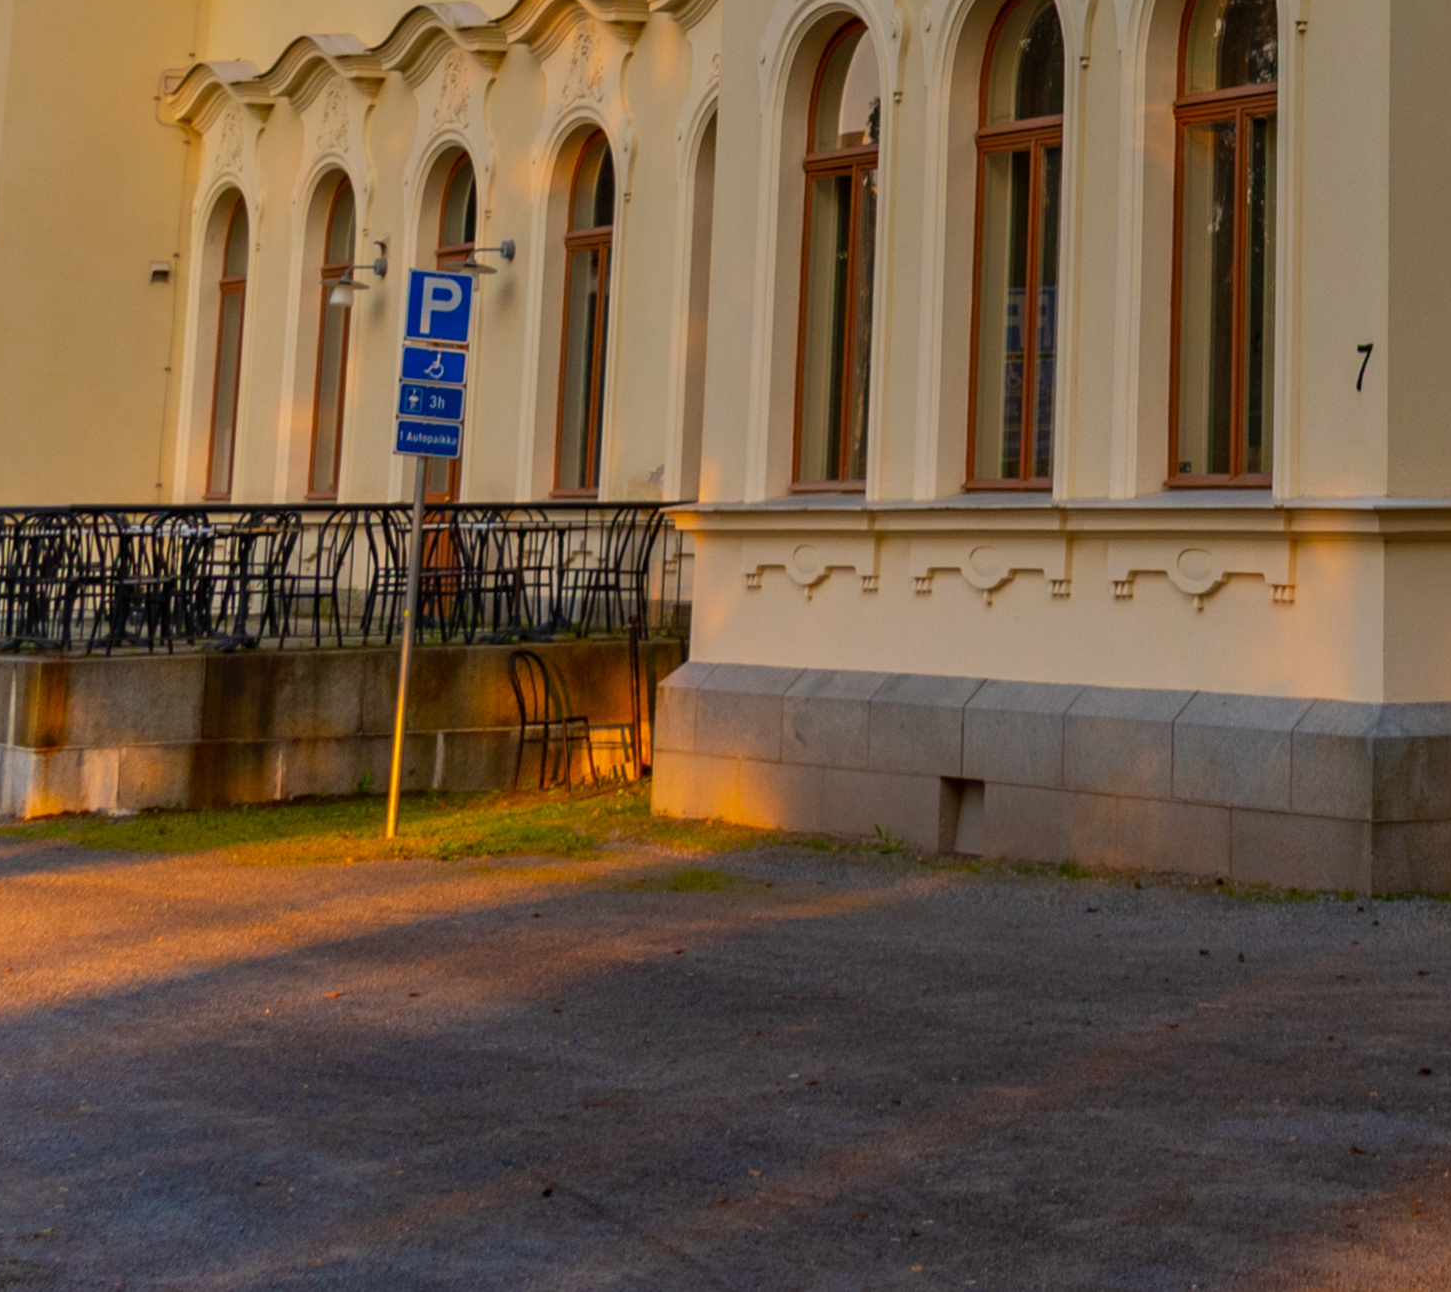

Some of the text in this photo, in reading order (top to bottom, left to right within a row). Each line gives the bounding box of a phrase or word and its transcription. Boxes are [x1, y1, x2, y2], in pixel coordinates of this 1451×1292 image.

[420, 276, 462, 334] P
[1356, 343, 1373, 392] 7
[429, 395, 445, 410] 3h
[406, 431, 457, 446] Autopaikka
